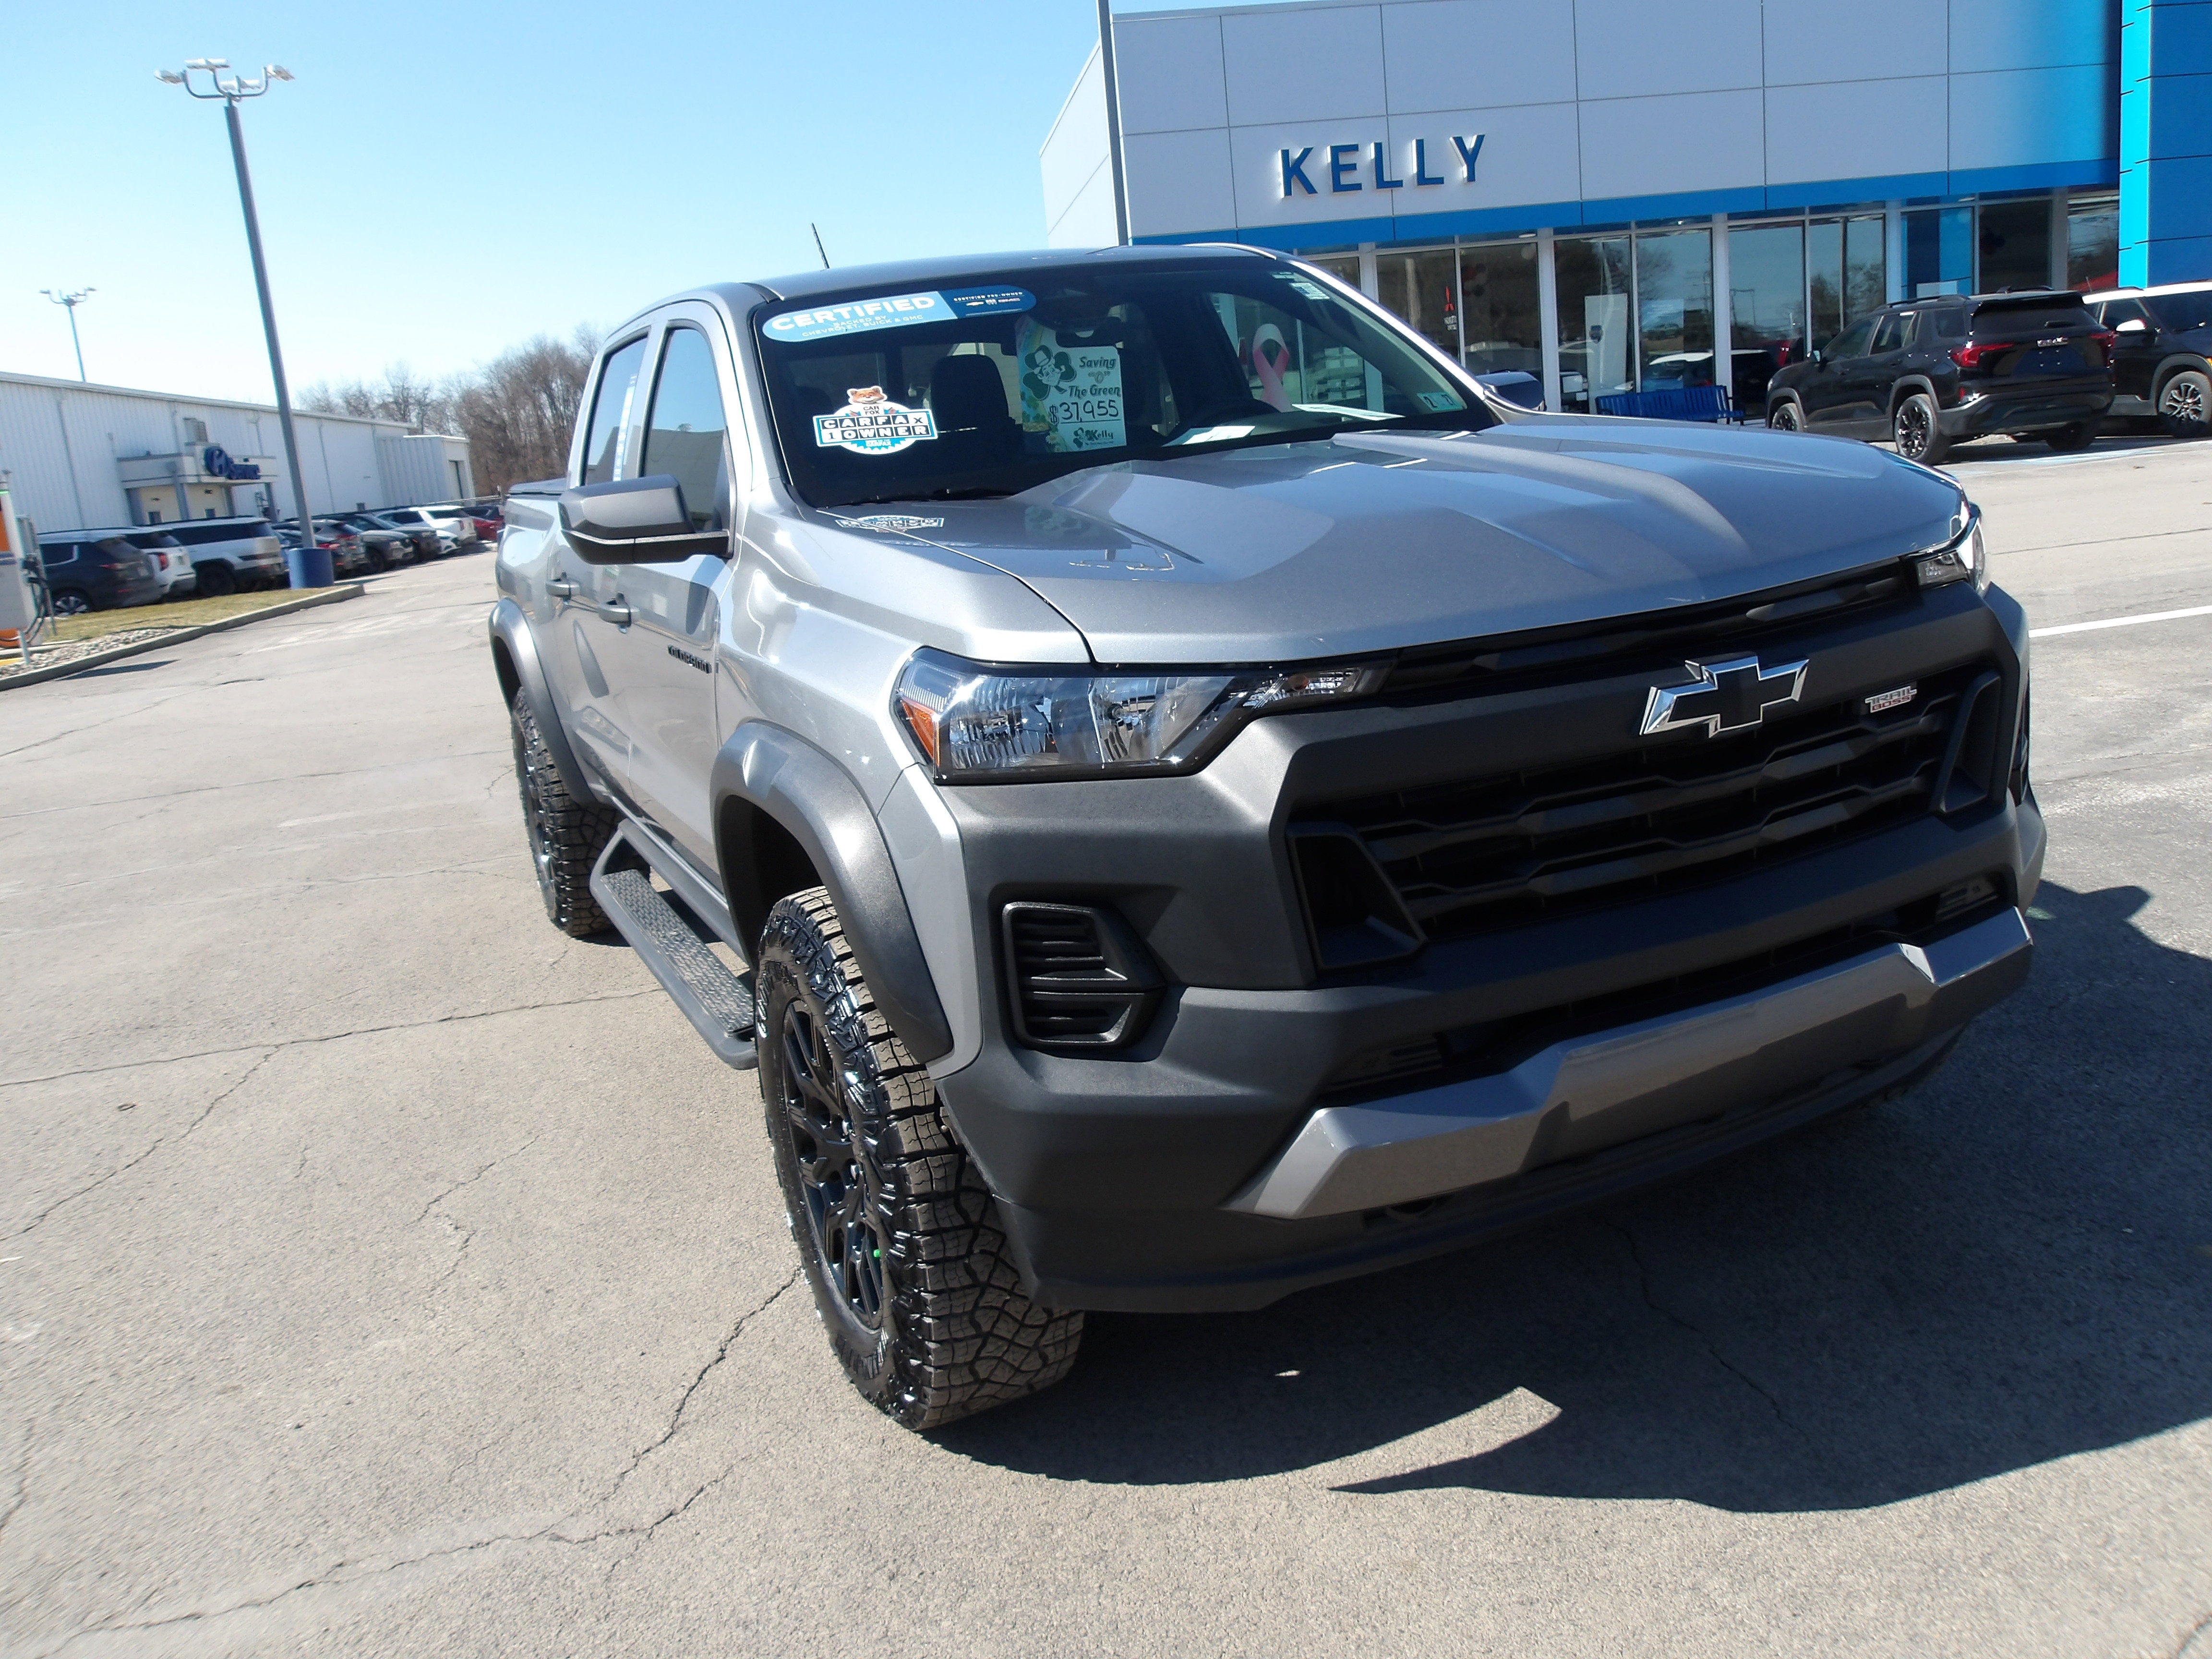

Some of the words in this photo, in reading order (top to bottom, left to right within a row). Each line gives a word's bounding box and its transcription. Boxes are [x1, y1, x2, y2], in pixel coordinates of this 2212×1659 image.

[1279, 134, 1485, 197] KELLY
[771, 297, 935, 330] CERTIFIED
[833, 317, 872, 327] BACKED
[1079, 356, 1117, 369] Saving
[1069, 385, 1087, 398] The
[1090, 385, 1121, 397] Green
[822, 415, 923, 429] CARFAX
[843, 426, 927, 439] OWNER
[1865, 686, 1917, 705] TRAIL
[1873, 695, 1911, 710] BOSS
